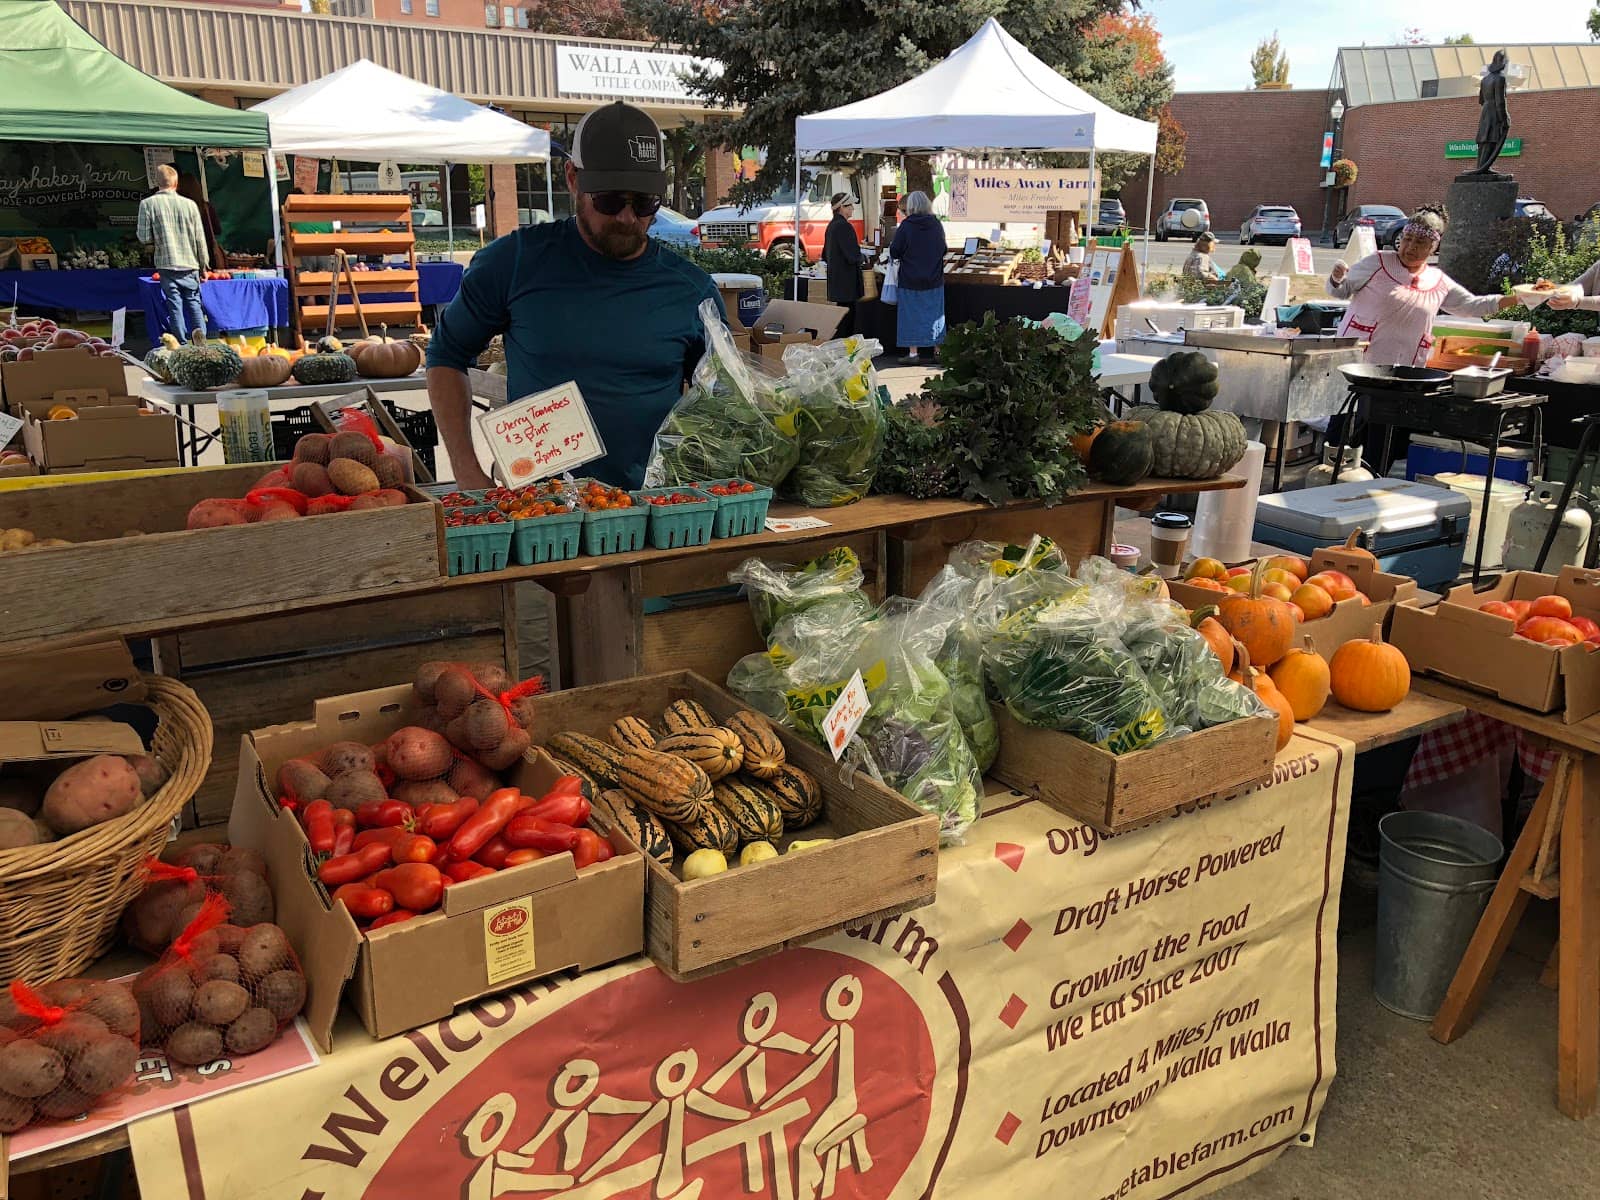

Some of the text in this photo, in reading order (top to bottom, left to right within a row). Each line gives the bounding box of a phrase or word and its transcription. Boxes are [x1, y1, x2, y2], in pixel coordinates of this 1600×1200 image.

[568, 53, 641, 75] WALLA
[592, 75, 631, 89] TITLE
[638, 149, 657, 159] ROOTS
[974, 177, 1096, 192] Miles Away Farm
[496, 398, 570, 435] Cherry Tomatoes
[1053, 887, 1121, 936] Draft
[1124, 863, 1192, 910] Horse
[1195, 825, 1286, 882] Powered
[1050, 903, 1251, 1010] Growing the Food
[1046, 940, 1249, 1052] We Eat Since 2007
[1035, 1019, 1291, 1159] Downtown Walla Walla
[1040, 997, 1260, 1123] Located 4 Miles from
